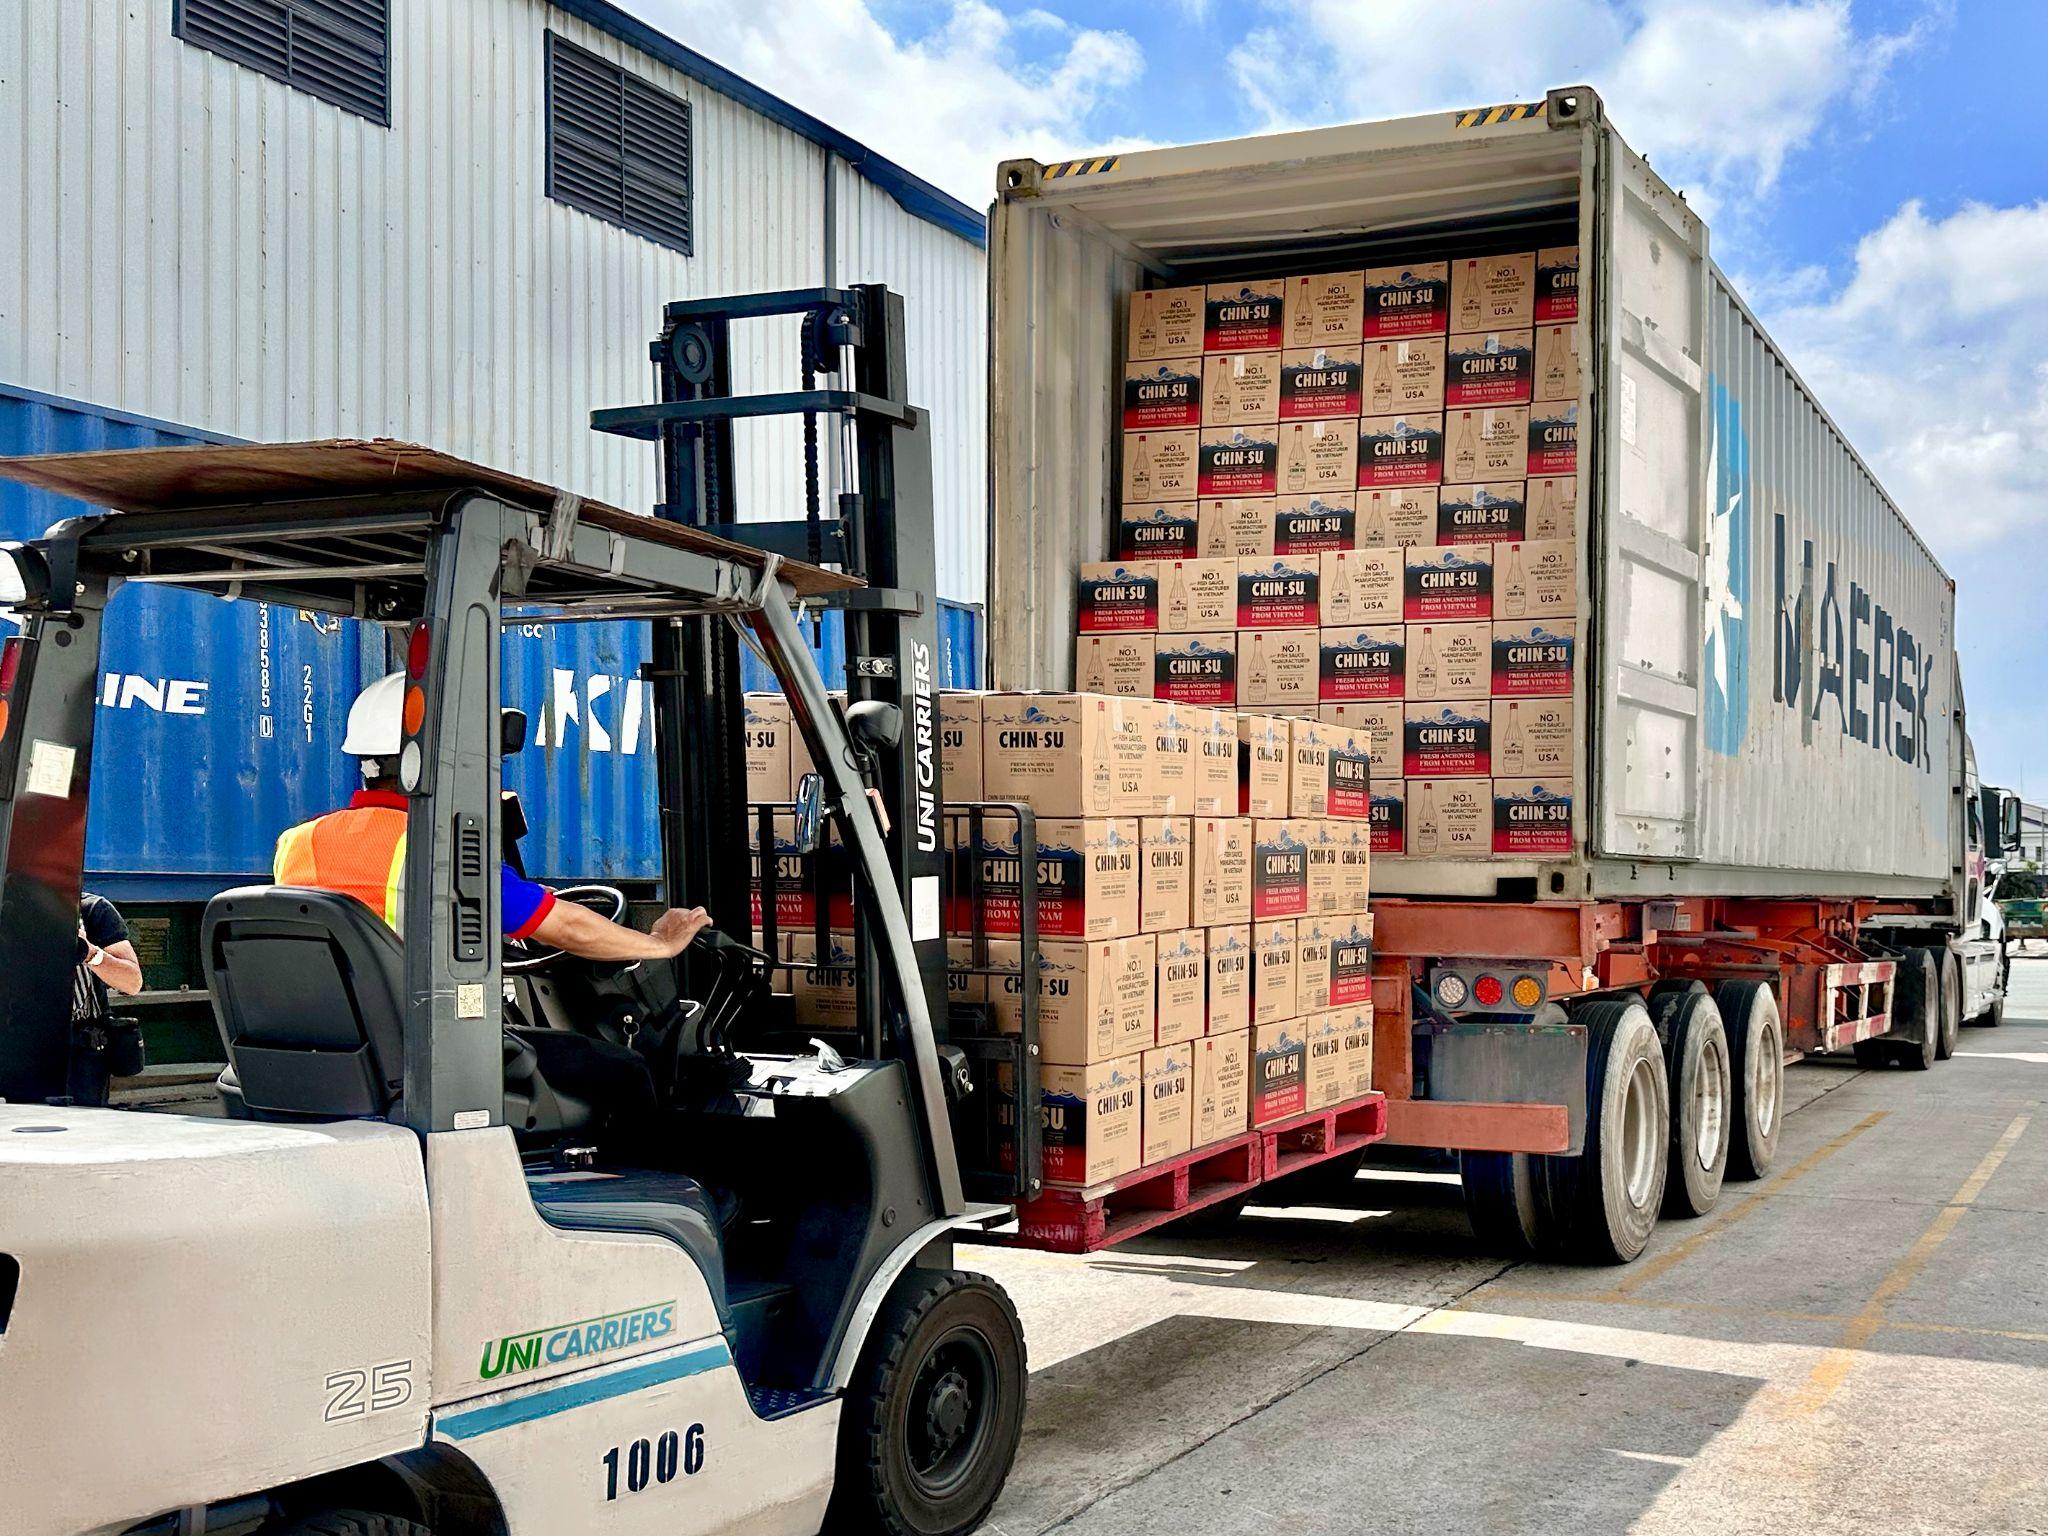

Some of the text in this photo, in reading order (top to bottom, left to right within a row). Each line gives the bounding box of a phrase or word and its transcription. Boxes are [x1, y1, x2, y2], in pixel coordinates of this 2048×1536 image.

[1379, 289, 1432, 306] CHIN-SU
[1219, 304, 1269, 321] CHIN-SU
[1493, 307, 1513, 315] USA
[1325, 322, 1344, 330] USA
[1462, 356, 1517, 374] CHIN-SU
[1294, 371, 1347, 387] CHIN-SU
[1138, 383, 1187, 399] CHIN-SU
[1405, 391, 1424, 399] USA
[1243, 402, 1260, 410] USA
[1544, 425, 1576, 442] CHIN
[1374, 439, 1427, 456] CHIN-SU
[1213, 450, 1264, 465] CHIN-SU
[1487, 459, 1506, 467] USA
[1319, 470, 1337, 478] USA
[1162, 480, 1180, 488] USA
[1288, 517, 1340, 533] CHIN-SU
[1453, 509, 1508, 525] CHIN-SU
[1134, 526, 1183, 541] CHIN-SU
[1398, 539, 1416, 547] USA
[1420, 571, 1477, 587] CHIN-SU
[1094, 585, 1144, 600] CHIN-SU
[1252, 580, 1304, 596] CHIN-SU
[1364, 601, 1383, 609] USA
[1540, 594, 1560, 602] USA
[1773, 514, 1932, 773] MAERSK
[260, 602, 270, 708] 38585
[1335, 652, 1389, 667] CHIN-SU
[1508, 646, 1565, 662] CHIN-SU
[1169, 658, 1221, 673] CHIN-SU
[1451, 677, 1470, 685] USA
[96, 673, 208, 714] INE
[304, 665, 312, 742] 22G1
[999, 731, 1064, 748] CHIN-SU
[1419, 728, 1474, 743] CHIN-SU
[1156, 736, 1188, 753] CHIN-SU
[1203, 741, 1231, 758] CHIN-SU
[1257, 746, 1282, 763] CHIN-SU
[1298, 749, 1325, 766] CHIN-SU
[1537, 753, 1557, 761] USA
[1336, 760, 1364, 779] CHIN-SU
[1122, 781, 1138, 792] USA
[1509, 805, 1566, 819] CHIN-SU
[1095, 853, 1131, 872] CHIN-SU
[1151, 851, 1183, 868] CHIN-SU
[1266, 855, 1299, 873] CHIN-SU
[1310, 849, 1336, 864] CHIN-SU
[1342, 849, 1366, 864] CHIN-SU
[983, 861, 1063, 885] CHISU
[1226, 894, 1239, 903] USA
[1264, 950, 1290, 966] CHIN-SU
[1302, 945, 1327, 962] CHIN-SU
[1338, 947, 1367, 966] CHIN-SU
[1168, 963, 1198, 981] CHIN-SU
[1218, 956, 1244, 973] CHIN-SU
[1004, 977, 1069, 1000] CH-SU
[1125, 1020, 1141, 1032] USA
[1313, 1039, 1338, 1057] CHIN-SU
[1345, 1032, 1369, 1051] CHIN-SU
[1265, 1055, 1299, 1079] CHIN-SU
[1154, 1077, 1184, 1100] CHIN-SU
[1098, 1091, 1132, 1115] CHIN-SU
[1223, 1106, 1236, 1117] USA
[325, 1360, 412, 1422] 25
[603, 1422, 705, 1500] 1006
